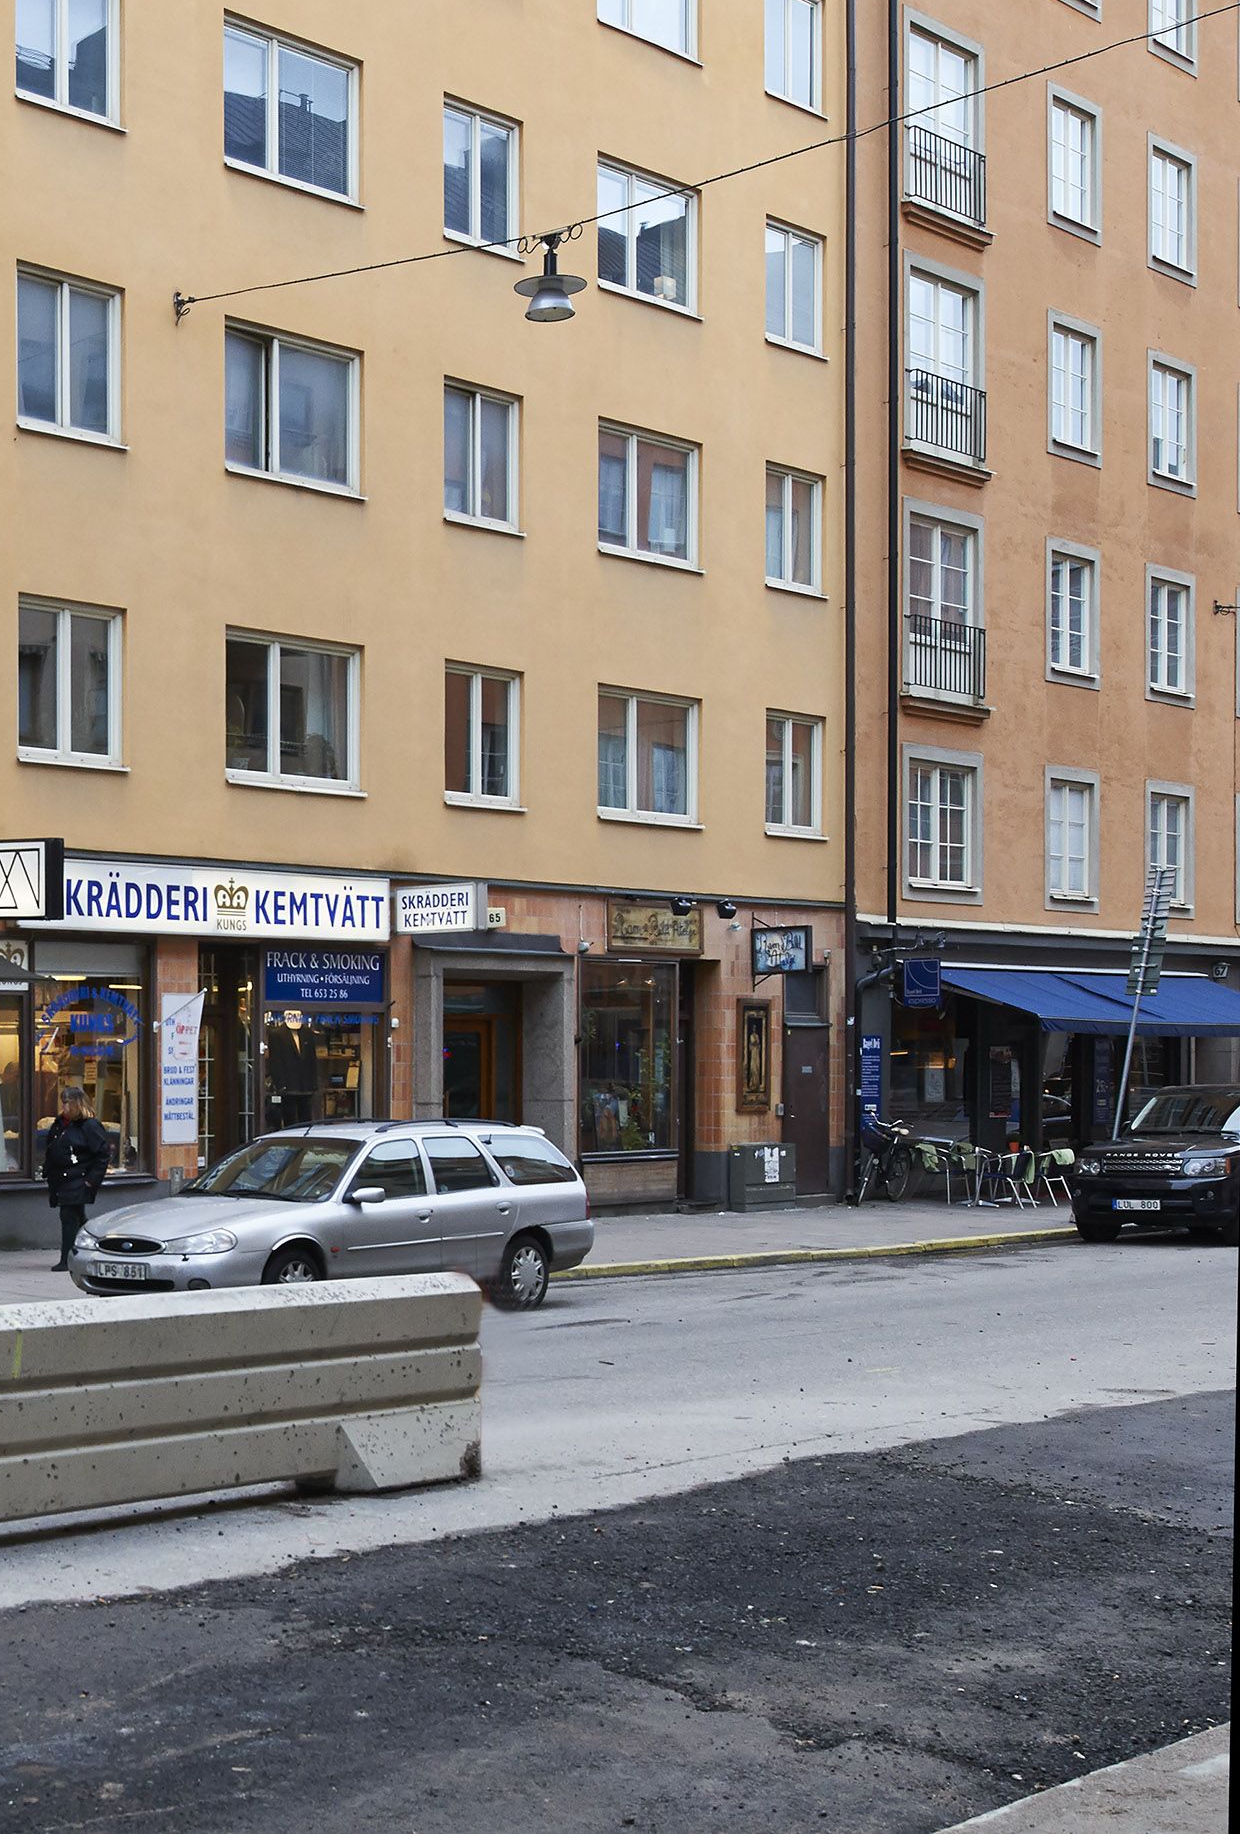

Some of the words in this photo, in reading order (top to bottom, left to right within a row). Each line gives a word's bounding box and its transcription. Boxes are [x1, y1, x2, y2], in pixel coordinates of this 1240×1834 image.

[66, 871, 207, 921] KRÄDDERI
[255, 886, 384, 929] KEMTVÄTT
[402, 891, 468, 909] SKRÄDDERI
[404, 908, 467, 927] KEMTVÄTT
[489, 913, 501, 923] 65
[216, 918, 247, 931] KUNGS
[267, 952, 306, 968] FRACK
[310, 953, 319, 968] &
[323, 954, 380, 971] SMOKING
[1215, 967, 1226, 976] 67
[277, 973, 319, 984] UTHYRNING
[301, 988, 312, 998] TEL
[315, 989, 327, 998] 653
[329, 989, 338, 998] 25
[340, 990, 348, 998] 86
[70, 1014, 114, 1032] KUNGS
[164, 1066, 177, 1074] BRUD
[184, 1065, 194, 1073] FEST
[1117, 1201, 1134, 1209] LUL
[1141, 1201, 1159, 1209] 800
[99, 1264, 117, 1276] LPS
[124, 1266, 143, 1278] 851
